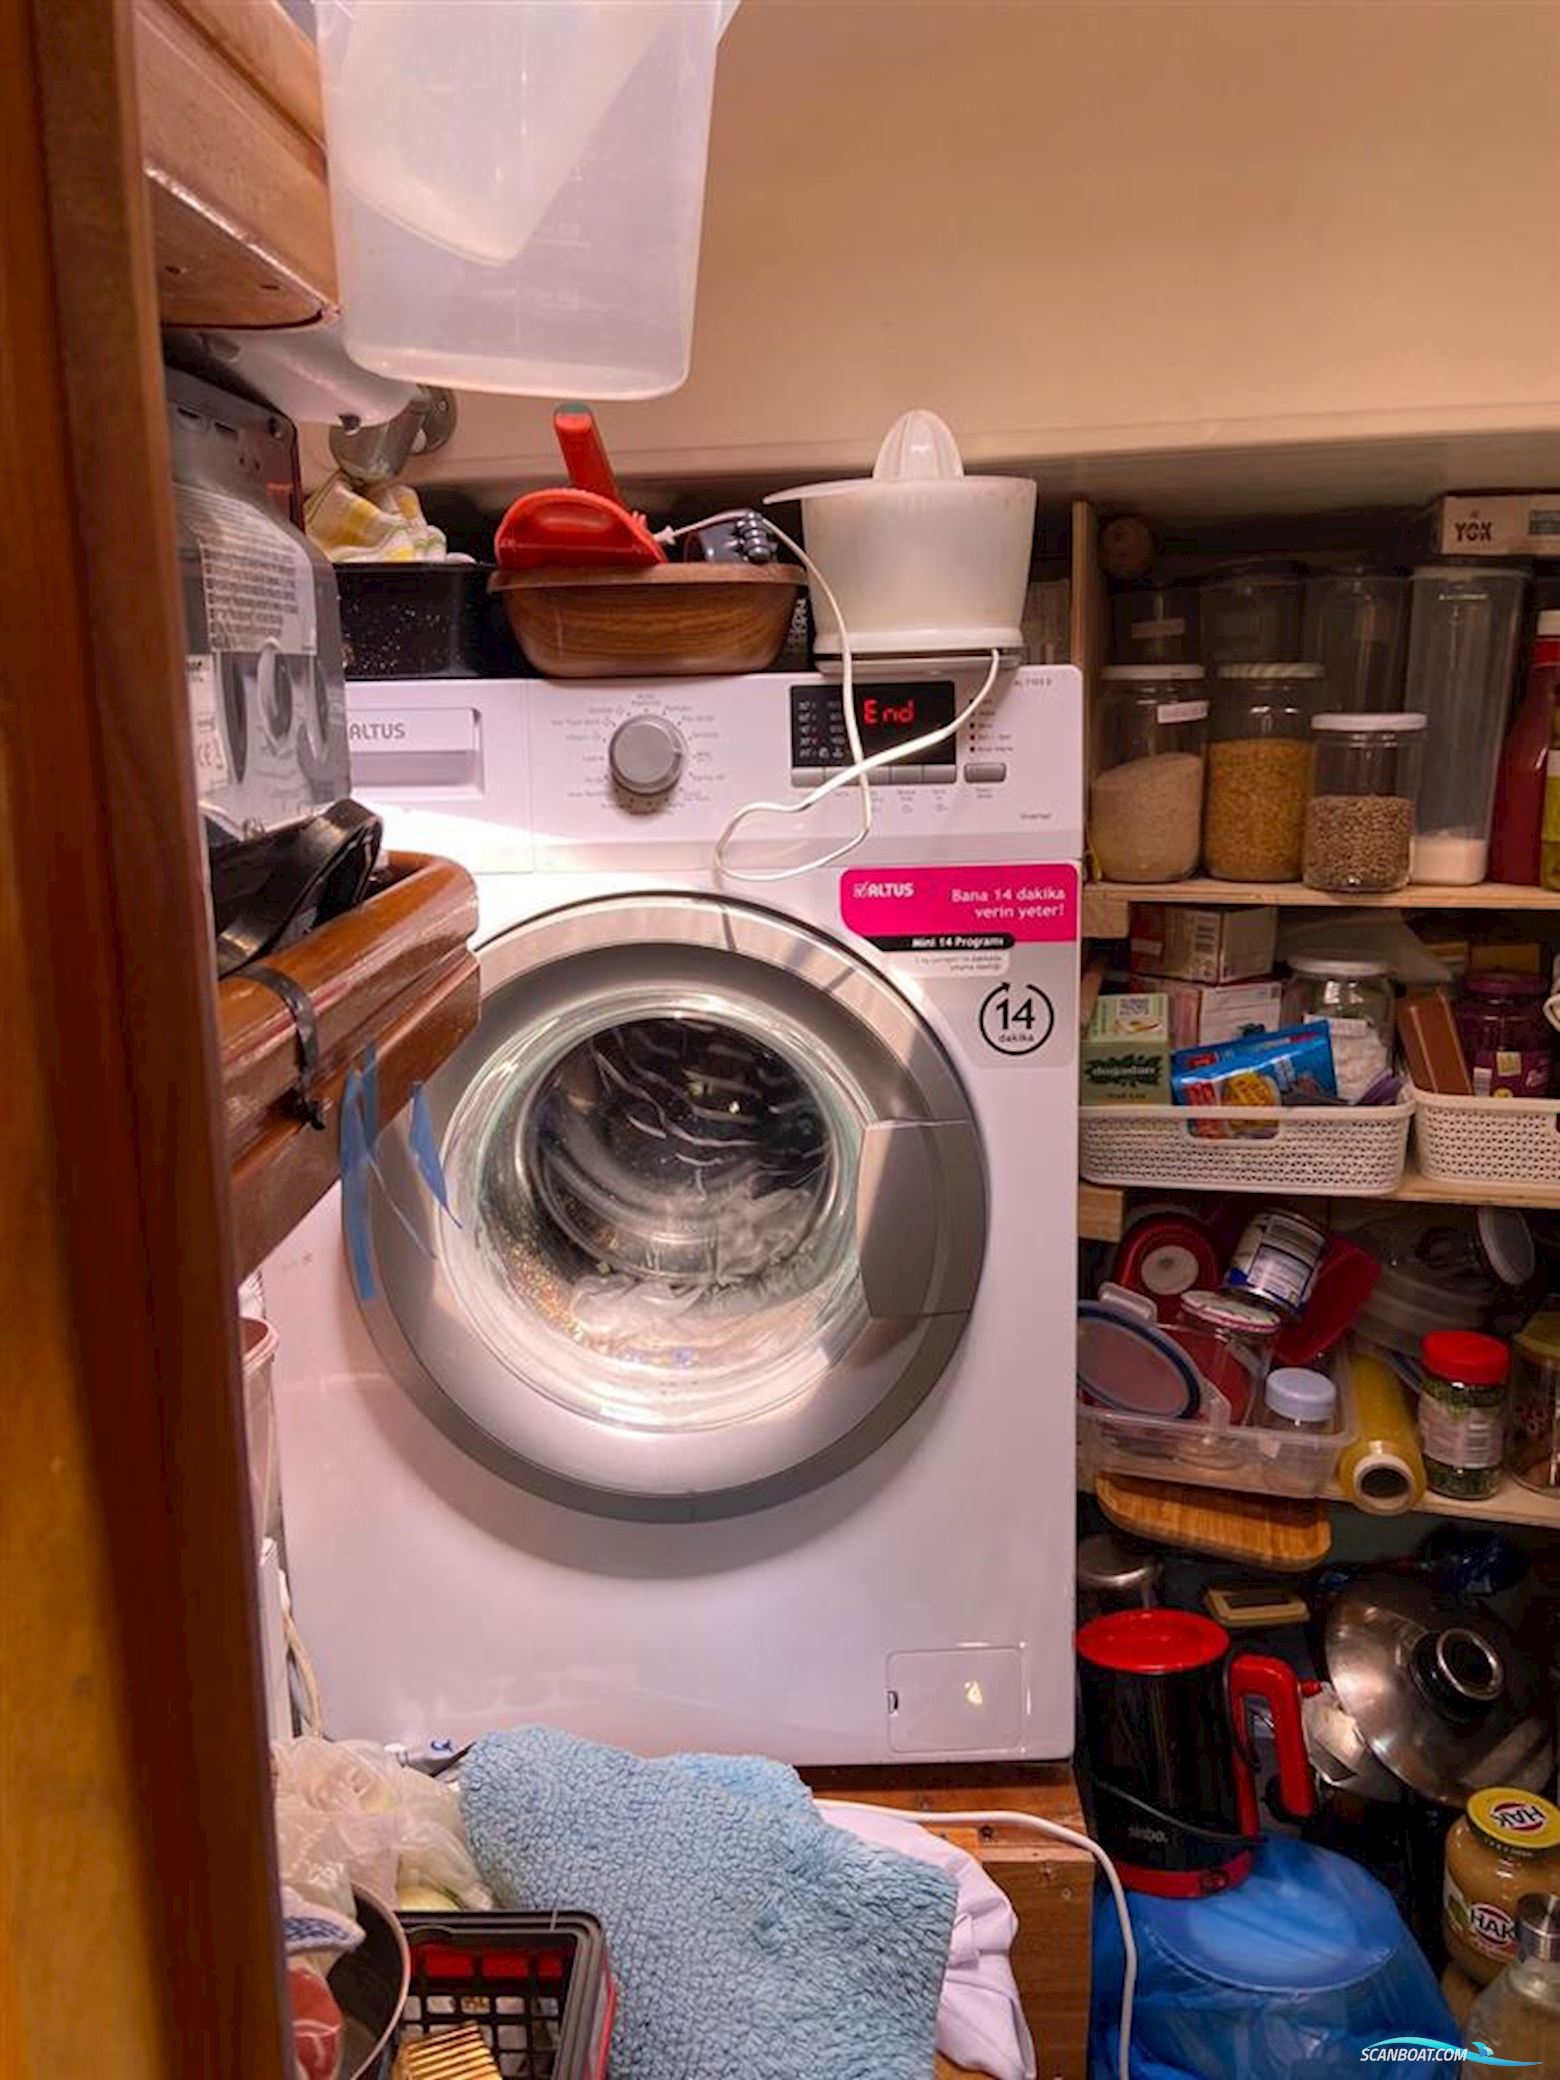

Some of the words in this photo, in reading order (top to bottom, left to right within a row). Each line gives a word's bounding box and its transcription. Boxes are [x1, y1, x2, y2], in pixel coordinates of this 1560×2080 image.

[863, 698, 915, 724] End
[349, 722, 406, 740] ALTUS
[867, 883, 915, 898] ALTUS
[951, 889, 989, 903] Bana
[994, 889, 1012, 902] 14
[1016, 887, 1065, 901] dakika
[975, 905, 1014, 918] verin
[1018, 904, 1065, 919] yeter!
[911, 937, 937, 948] Mini
[939, 937, 953, 948] 14
[996, 998, 1036, 1030] 14
[999, 1032, 1034, 1043] dakika
[1490, 1804, 1546, 1828] HAK
[1470, 1908, 1517, 1941] HAK
